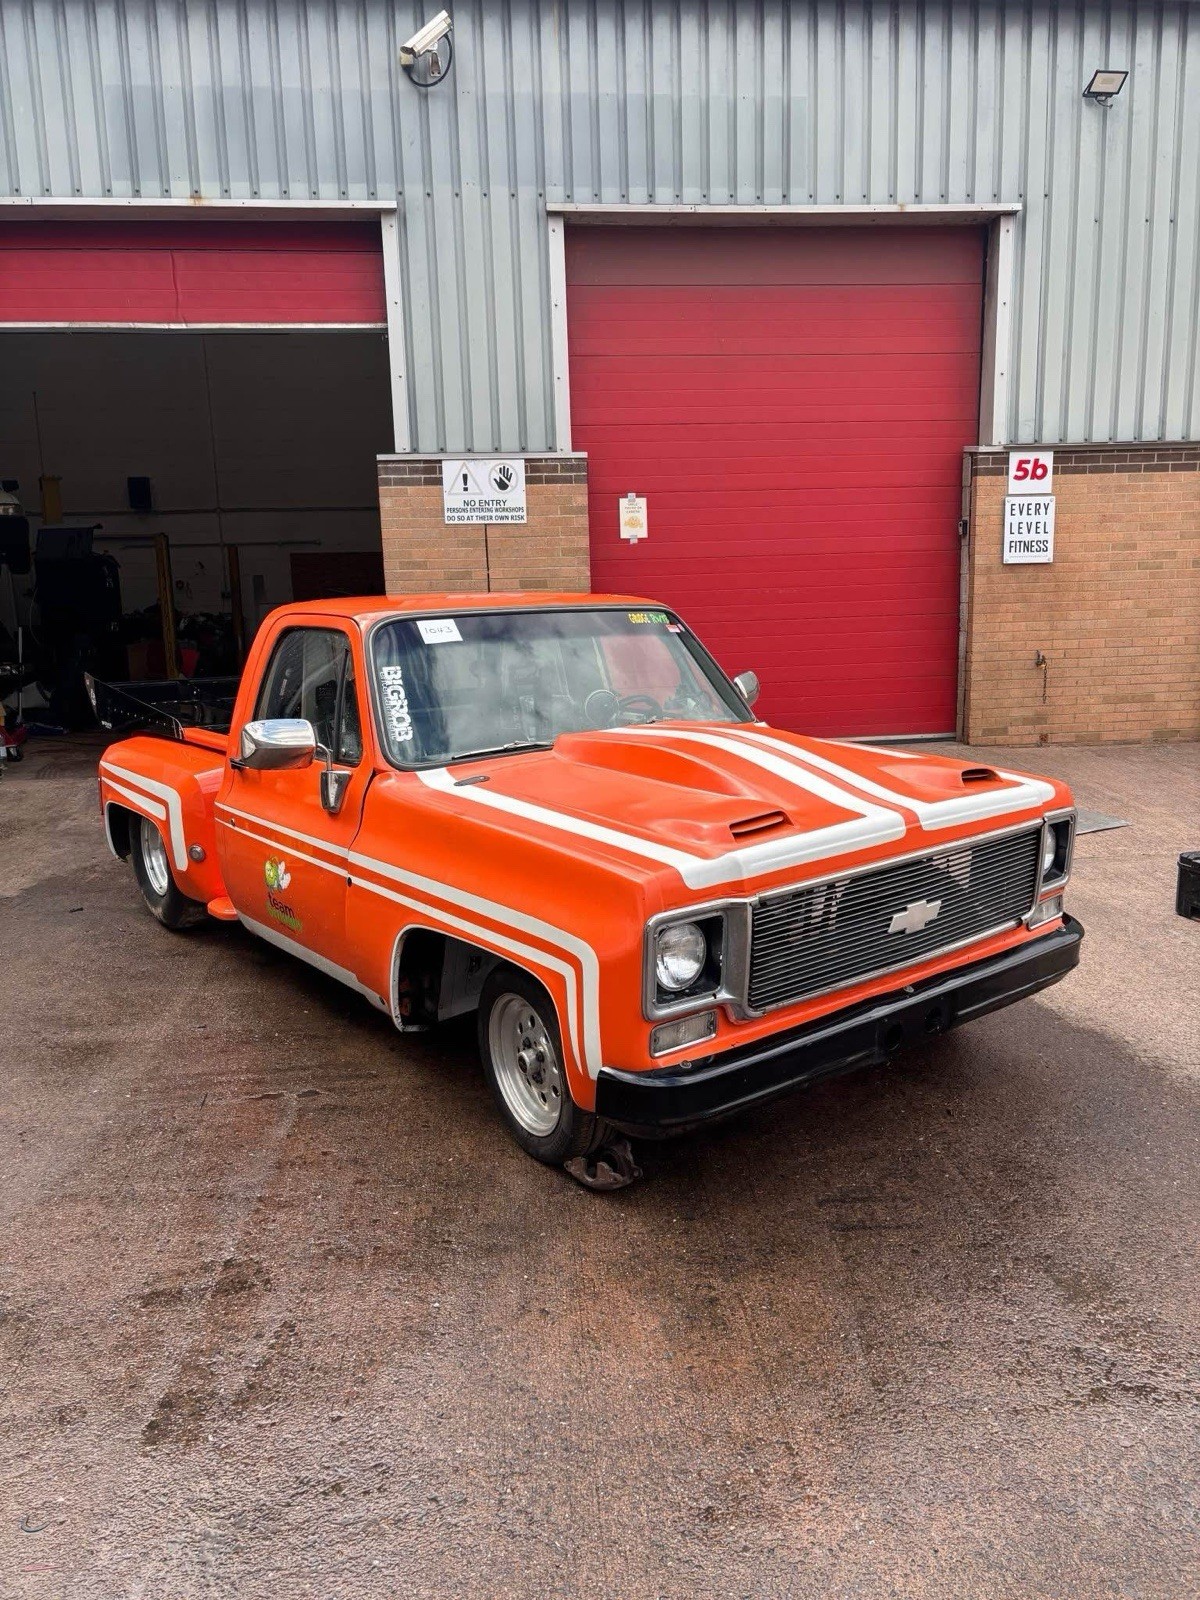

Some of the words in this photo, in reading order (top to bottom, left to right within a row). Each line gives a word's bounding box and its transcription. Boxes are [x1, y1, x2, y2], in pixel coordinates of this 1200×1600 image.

[1013, 458, 1048, 481] 5b
[1010, 503, 1050, 516] EVERY
[1009, 521, 1049, 535] LEVEL
[1009, 539, 1049, 553] FITNESS
[382, 666, 413, 742] BIGROB
[268, 891, 296, 919] team
